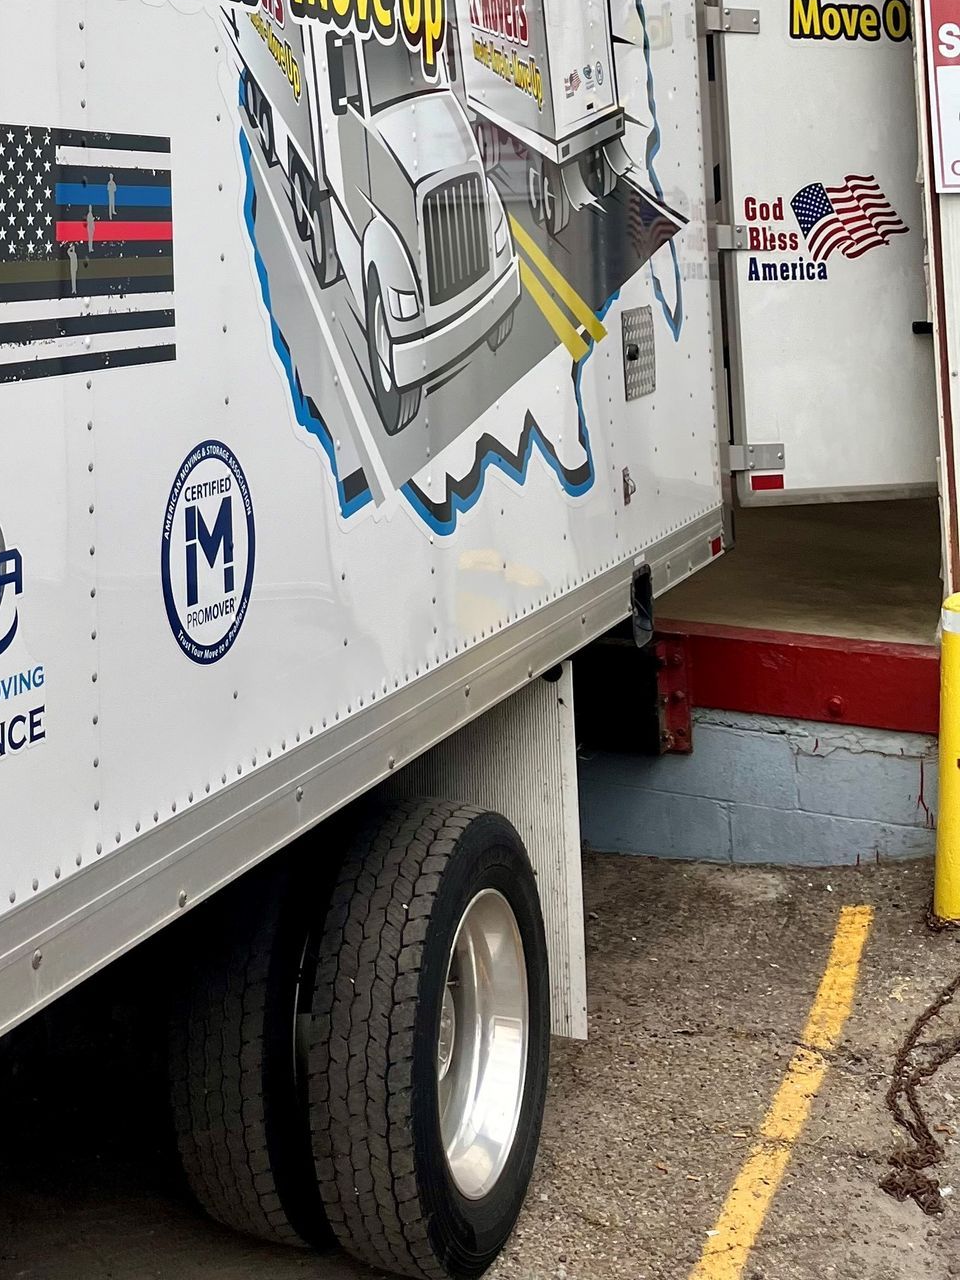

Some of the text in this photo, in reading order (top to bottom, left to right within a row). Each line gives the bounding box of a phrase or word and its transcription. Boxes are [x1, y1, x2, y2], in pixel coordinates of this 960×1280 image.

[284, 40, 300, 104] Up
[529, 56, 544, 111] Up
[744, 196, 784, 221] God
[748, 226, 799, 251] Bless
[748, 256, 828, 281] America
[163, 478, 182, 541] AMERICAN
[179, 449, 202, 482] MOVING
[206, 445, 230, 462] STORAGE
[228, 456, 252, 517] ASSOCIATION
[184, 476, 232, 503] CERTIFIED
[177, 628, 191, 652] Trust
[191, 643, 204, 659] Your
[203, 648, 219, 659] Move
[228, 596, 248, 642] ProMover
